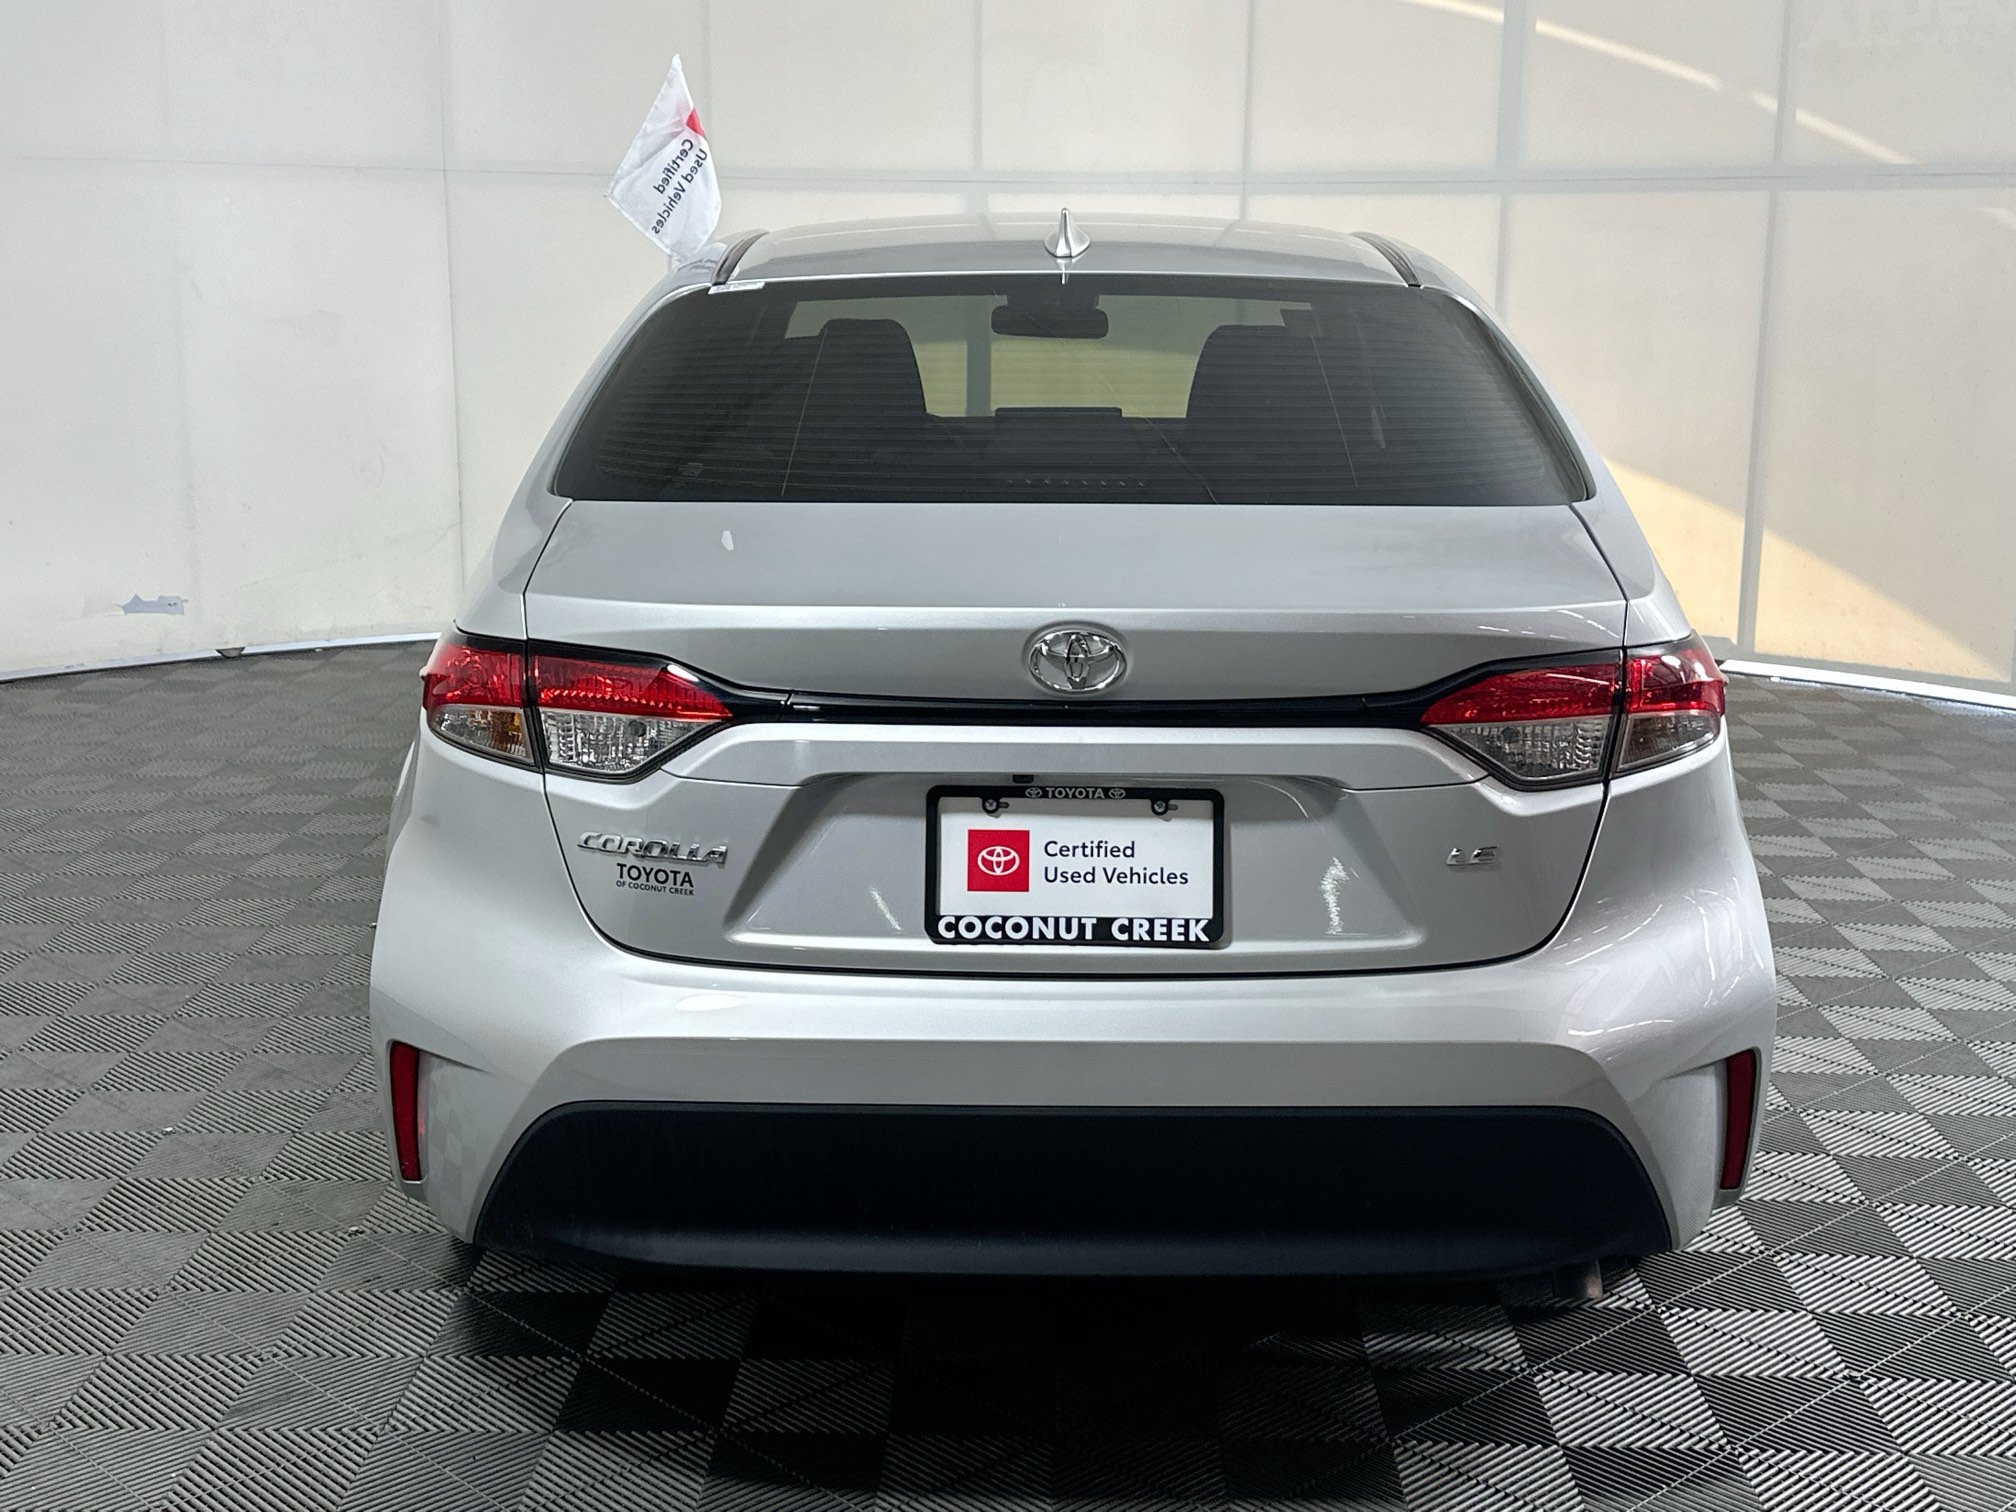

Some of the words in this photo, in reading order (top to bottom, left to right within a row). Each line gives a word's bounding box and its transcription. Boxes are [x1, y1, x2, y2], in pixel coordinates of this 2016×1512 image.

[1046, 787, 1105, 800] TOYOTA
[577, 832, 728, 867] COROLLA
[1043, 840, 1136, 859] Certified
[616, 862, 695, 888] TOYOTA
[1043, 866, 1096, 885] Used
[1102, 867, 1189, 886] Vehicles
[616, 880, 626, 888] OF
[628, 881, 667, 894] COCONUT
[669, 886, 695, 896] CREEK
[937, 916, 1098, 941] COCONUT
[1111, 918, 1210, 943] CREEK
